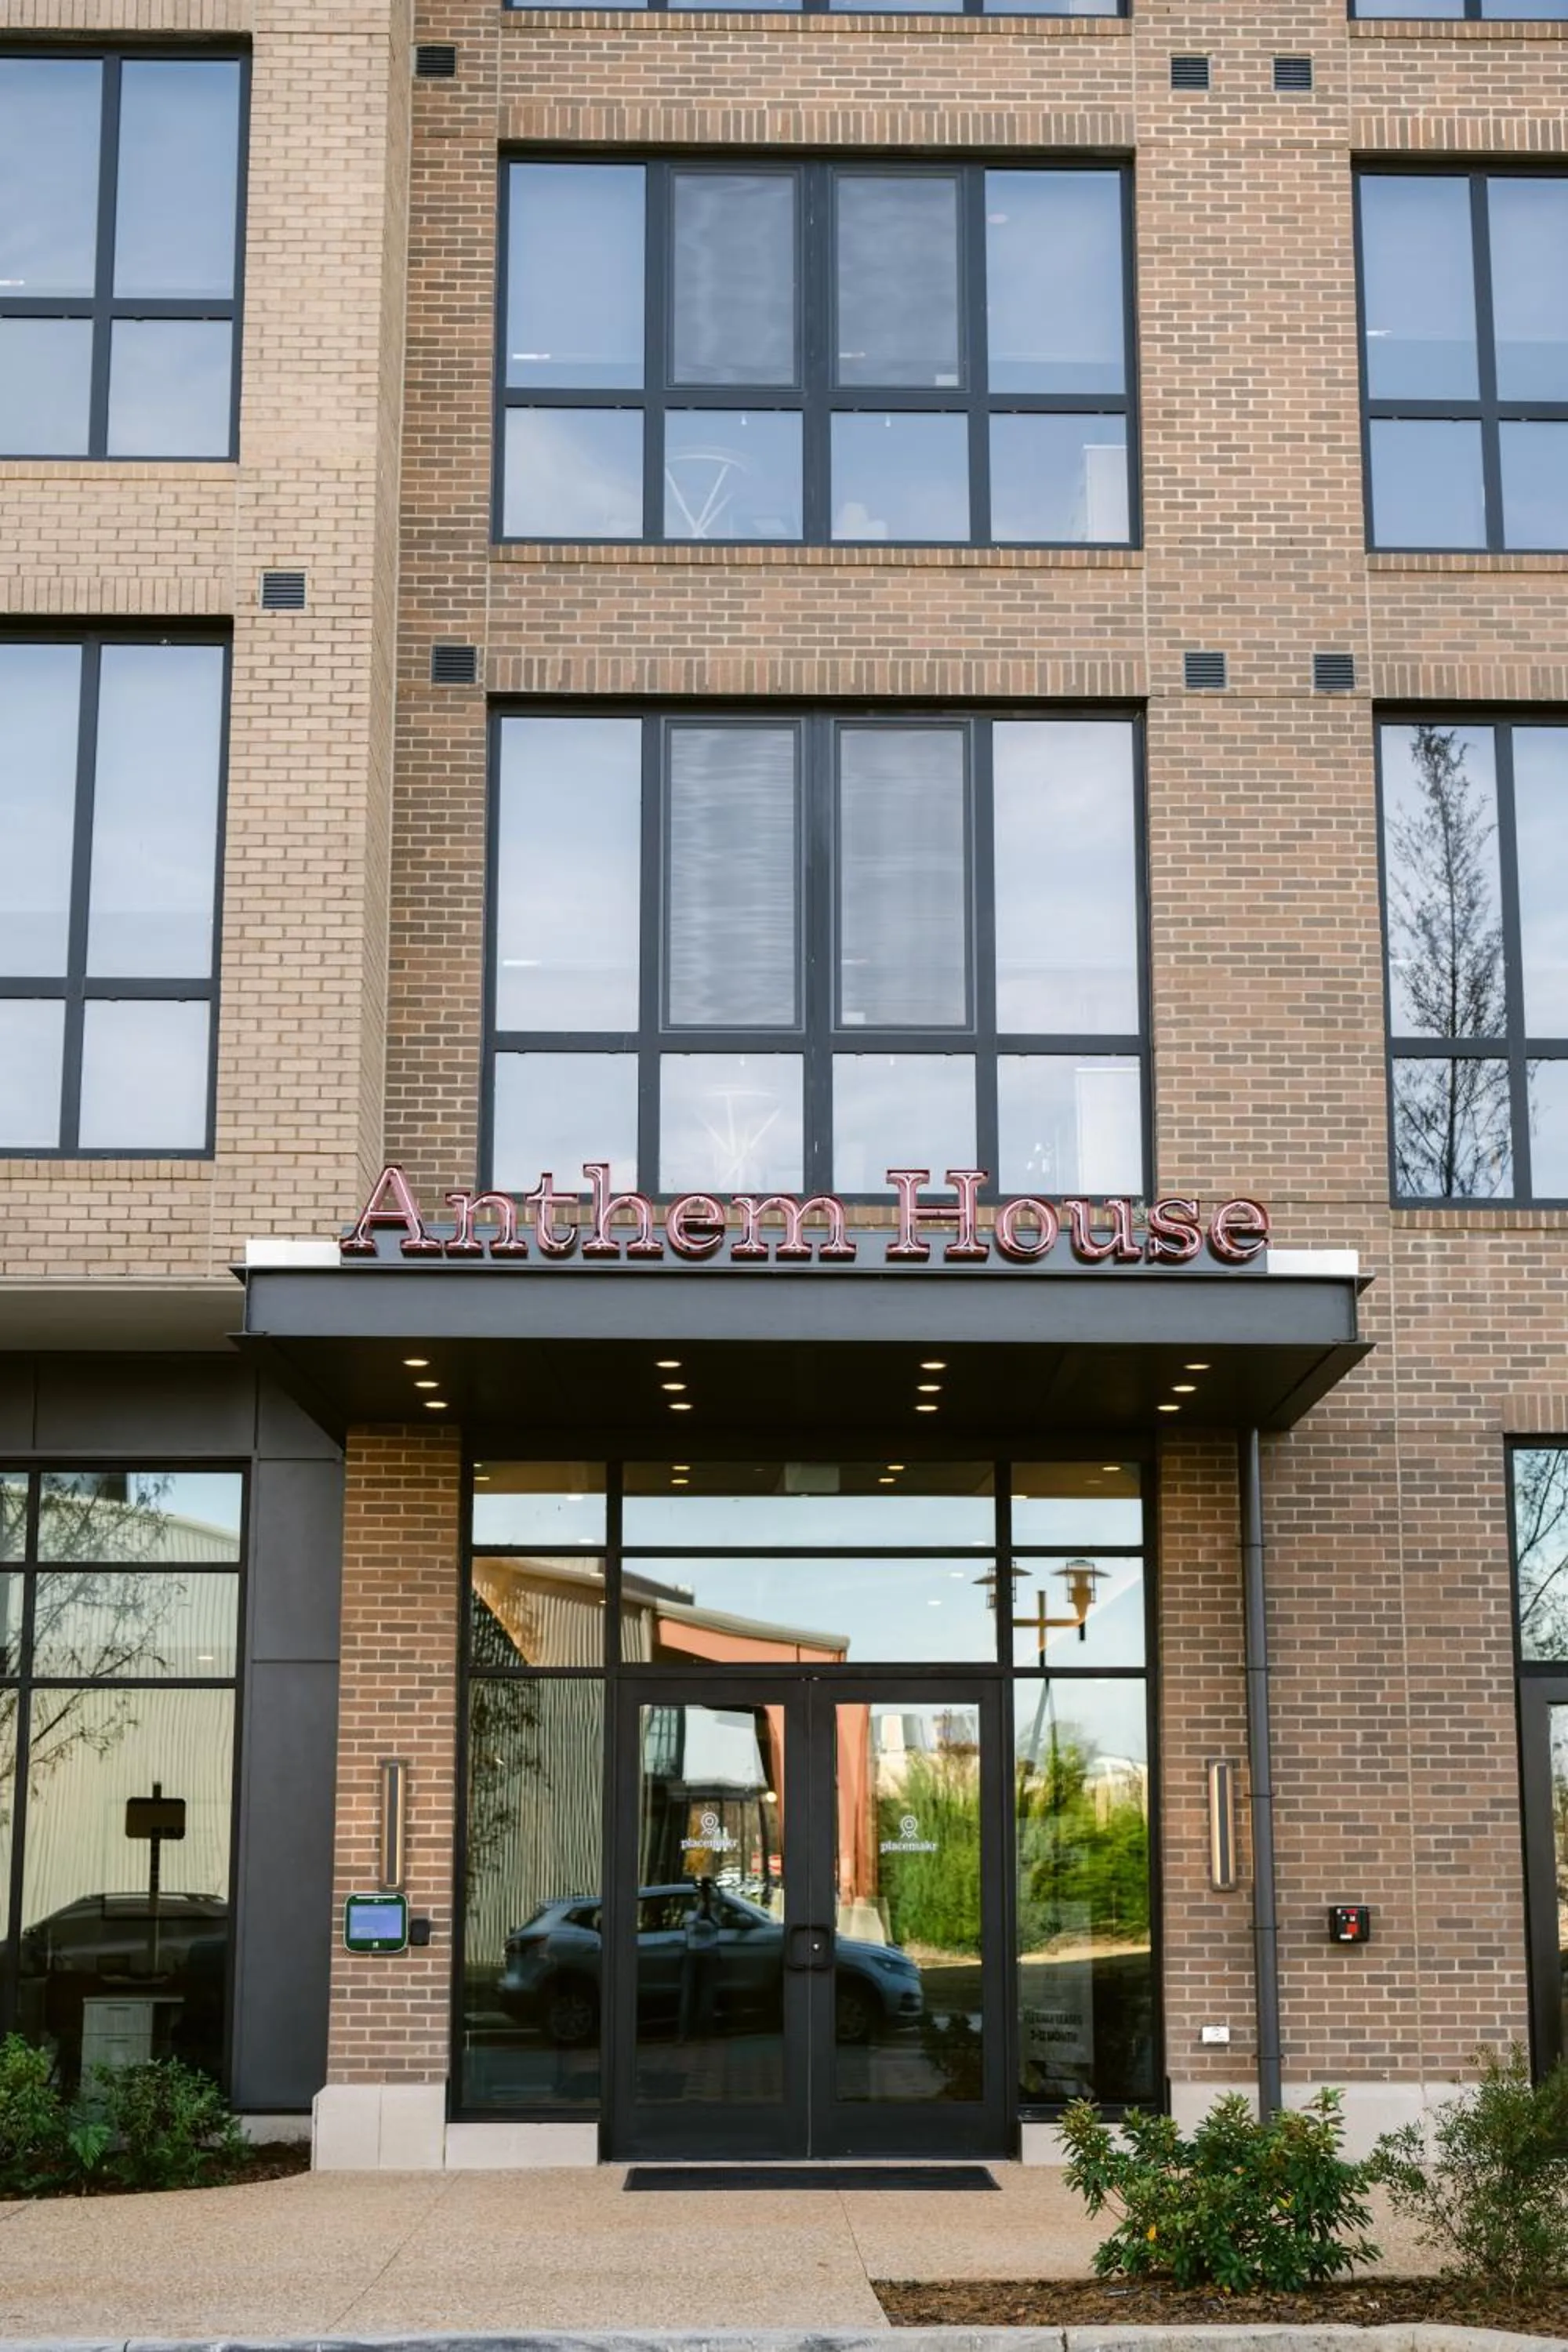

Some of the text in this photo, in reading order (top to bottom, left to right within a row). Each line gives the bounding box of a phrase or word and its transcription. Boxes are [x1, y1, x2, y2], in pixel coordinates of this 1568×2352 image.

[339, 1163, 1271, 1265] Anthem House
[880, 1839, 938, 1853] placemakr
